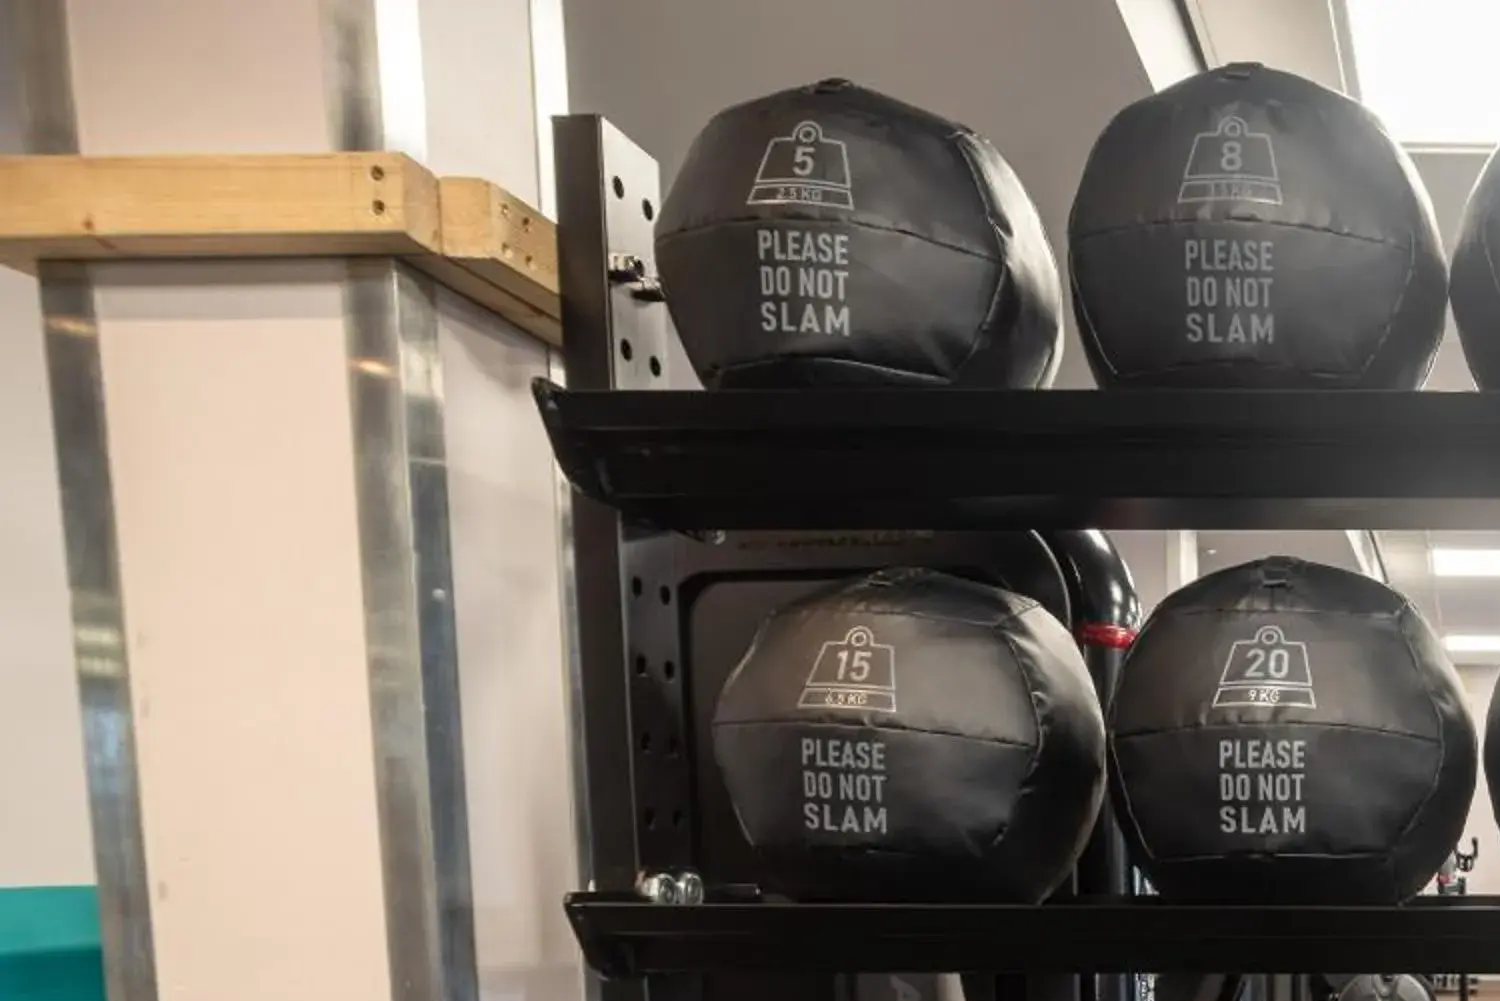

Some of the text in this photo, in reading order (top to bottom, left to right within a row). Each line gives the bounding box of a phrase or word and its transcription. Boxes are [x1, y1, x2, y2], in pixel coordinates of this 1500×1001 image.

[792, 146, 815, 176] 5
[1221, 141, 1242, 171] 8
[757, 229, 849, 265] PLEASE
[1185, 241, 1274, 272] PLEASE
[760, 266, 849, 301] DO NOT
[1187, 277, 1273, 309] DO NOT
[761, 302, 850, 336] SLAM
[1186, 314, 1274, 345] SLAM
[837, 650, 872, 681] 15
[1245, 648, 1289, 678] 20
[802, 737, 886, 771] PLEASE
[1219, 739, 1305, 769] PLEASE
[803, 771, 885, 802] DO NOT
[1220, 773, 1305, 801] DO NOT
[804, 803, 888, 834] SLAM
[1220, 806, 1305, 834] SLAM
